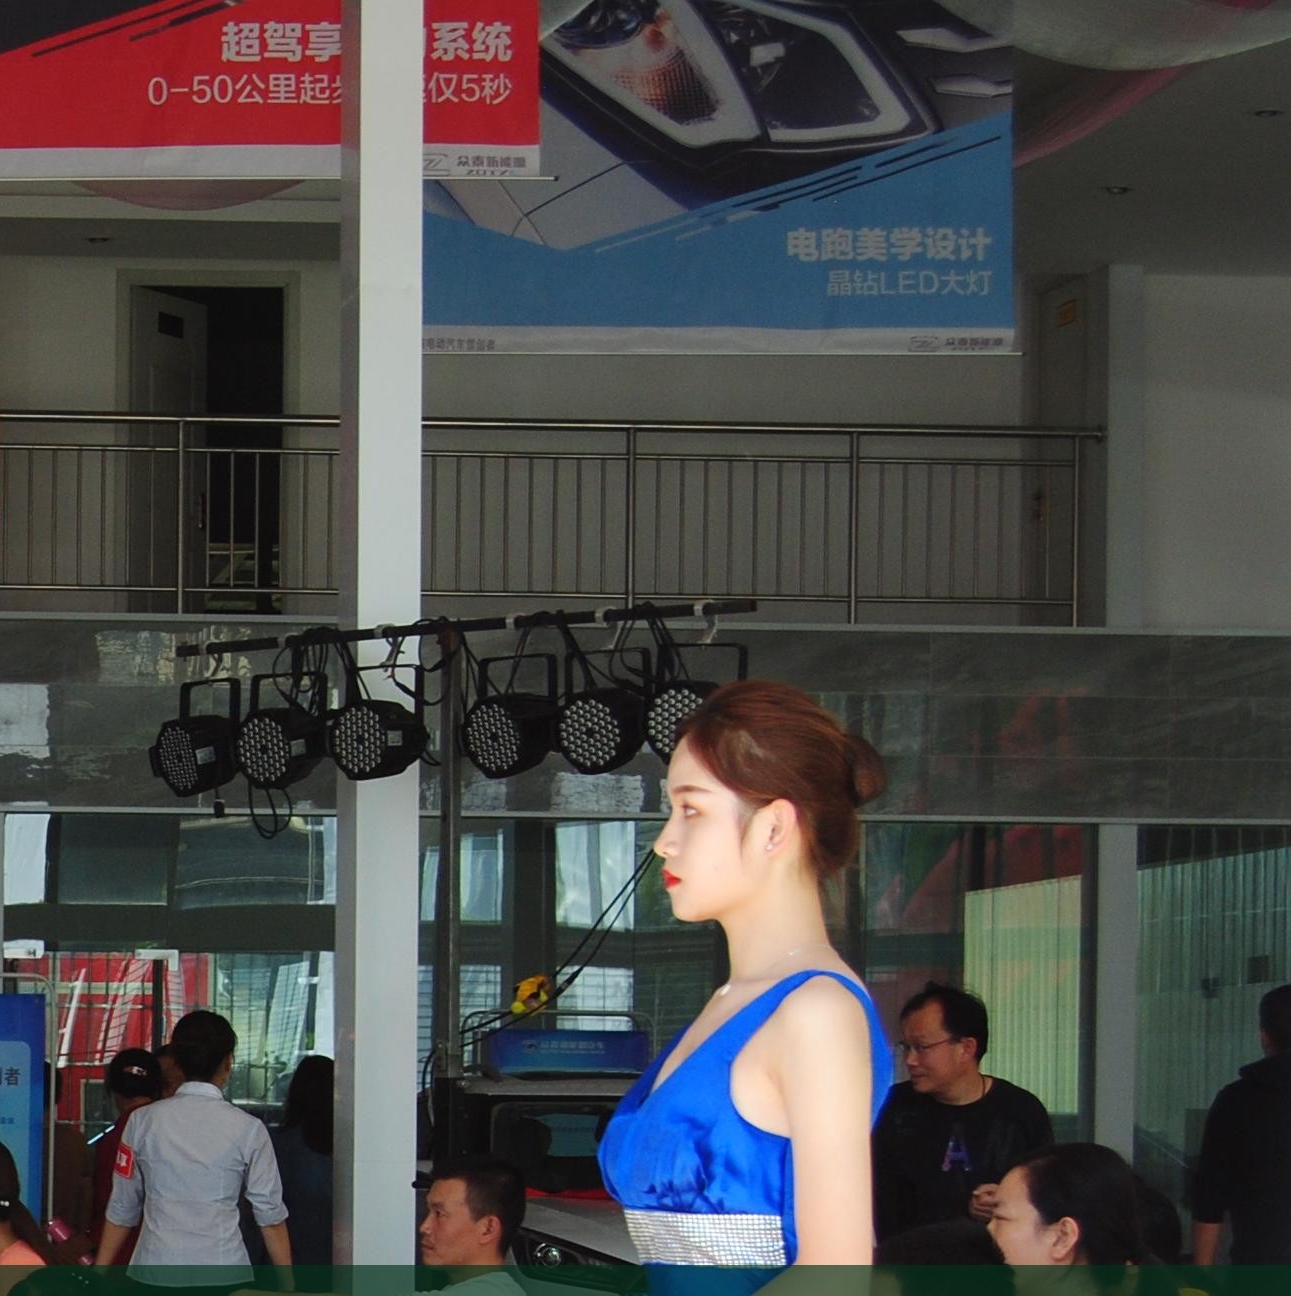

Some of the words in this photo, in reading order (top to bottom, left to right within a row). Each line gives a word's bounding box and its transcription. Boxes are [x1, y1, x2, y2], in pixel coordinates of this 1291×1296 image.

[221, 21, 512, 62] 超驾享系统
[786, 228, 992, 261] 电跑美学设计
[826, 271, 992, 297] 晶钻LED大灯
